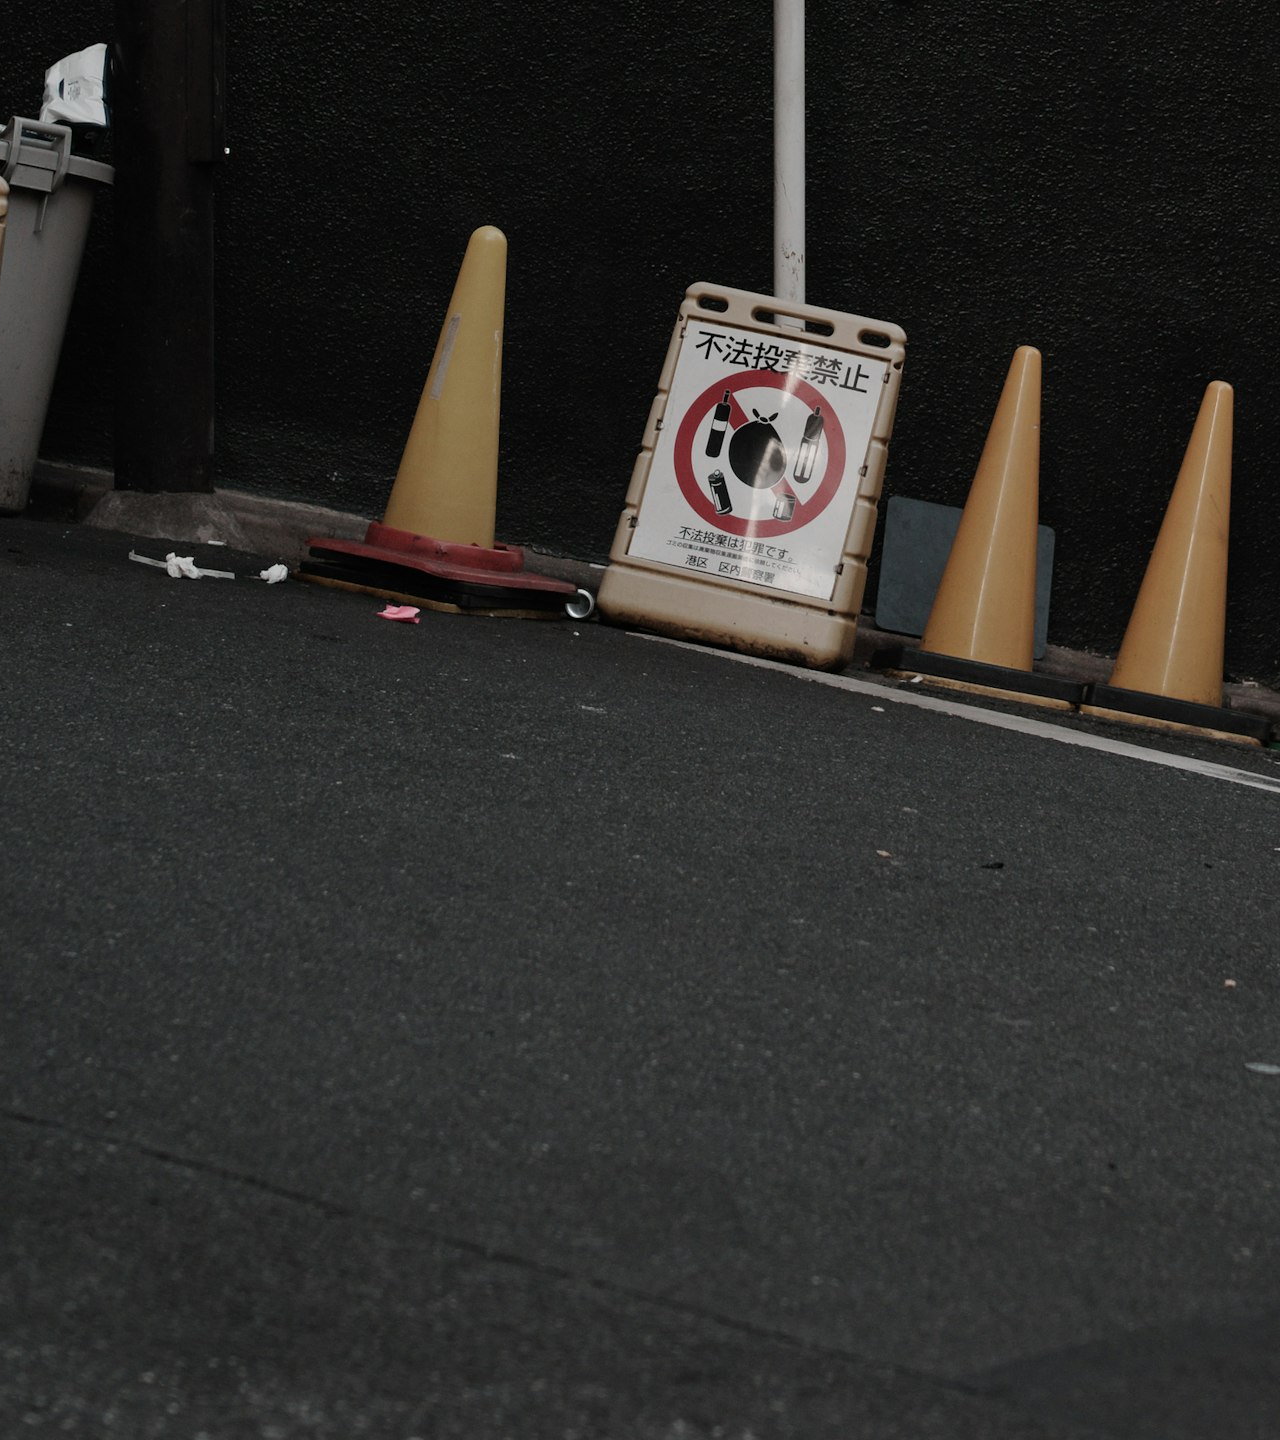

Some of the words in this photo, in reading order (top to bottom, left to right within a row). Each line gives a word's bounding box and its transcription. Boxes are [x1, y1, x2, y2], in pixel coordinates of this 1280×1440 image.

[696, 331, 870, 393] 不法投棄禁止
[685, 554, 708, 569] 港区
[719, 561, 775, 584] 区内察署
